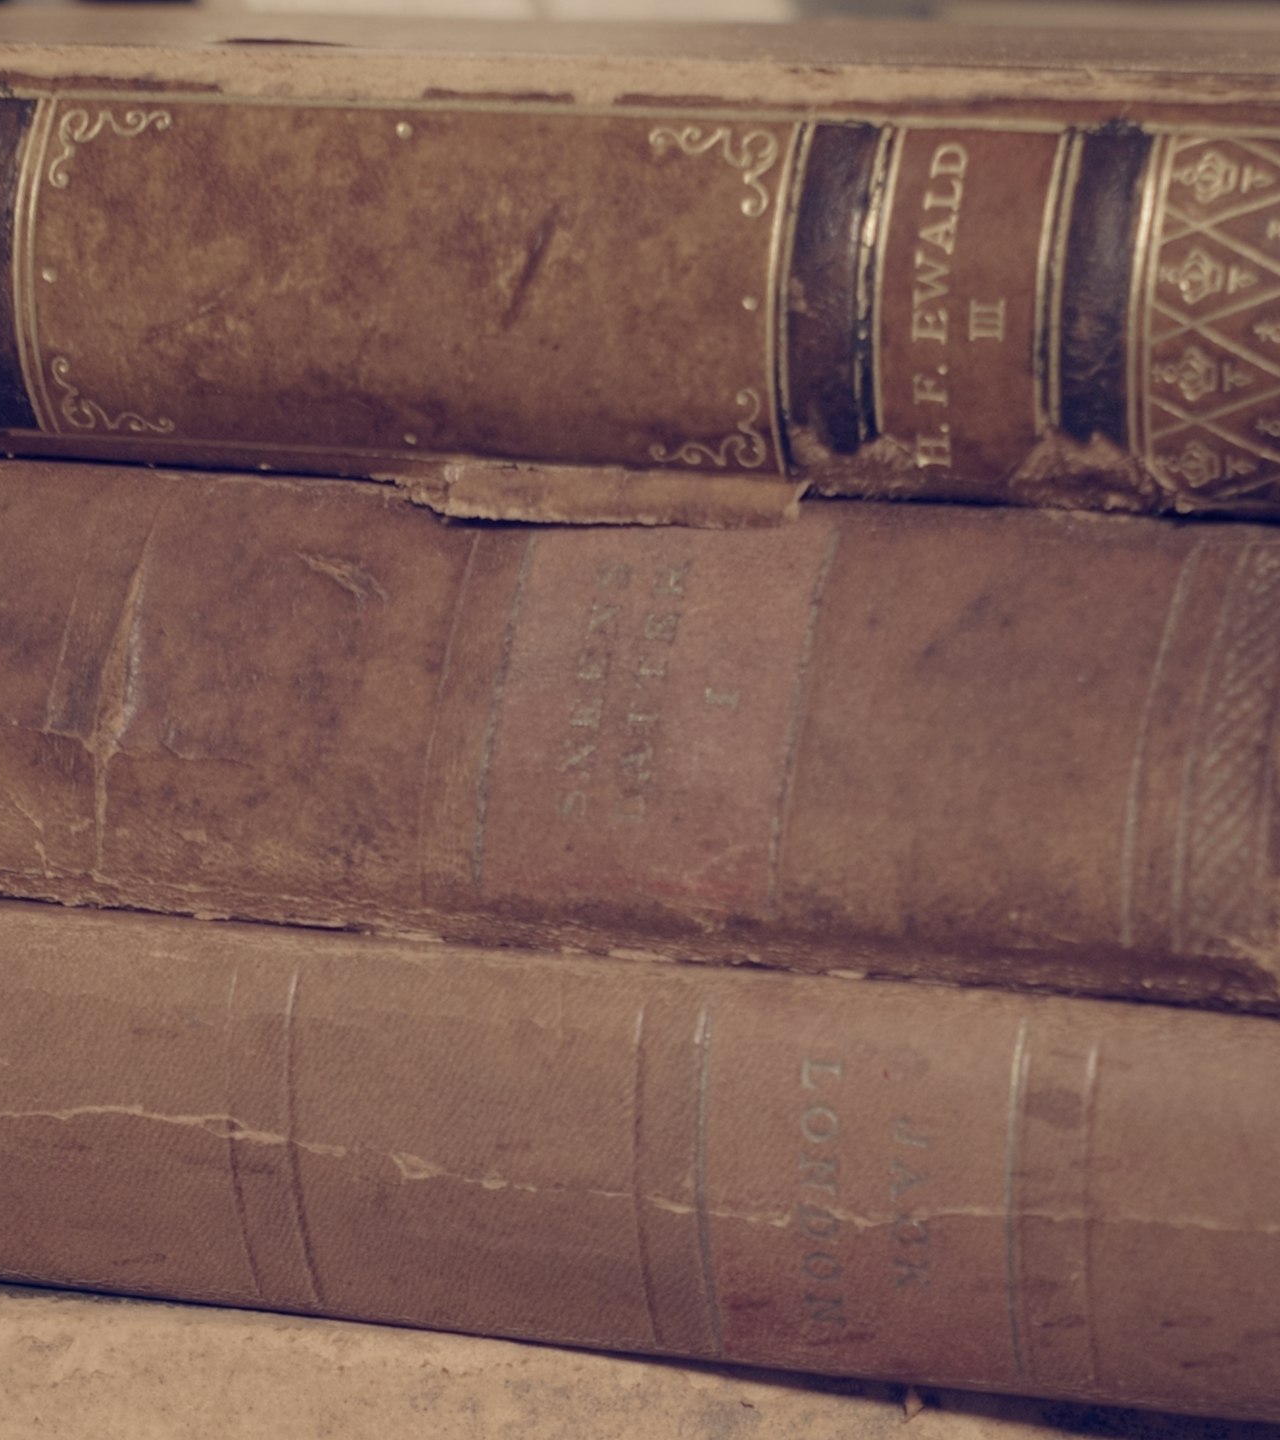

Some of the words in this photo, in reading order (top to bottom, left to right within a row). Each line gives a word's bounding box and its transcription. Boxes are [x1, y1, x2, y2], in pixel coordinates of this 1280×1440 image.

[911, 141, 970, 345] EWALD
[968, 298, 1006, 342] III
[912, 363, 948, 407] F.
[916, 423, 951, 468] H.
[703, 686, 742, 711] I
[796, 1056, 848, 1332] LONDON
